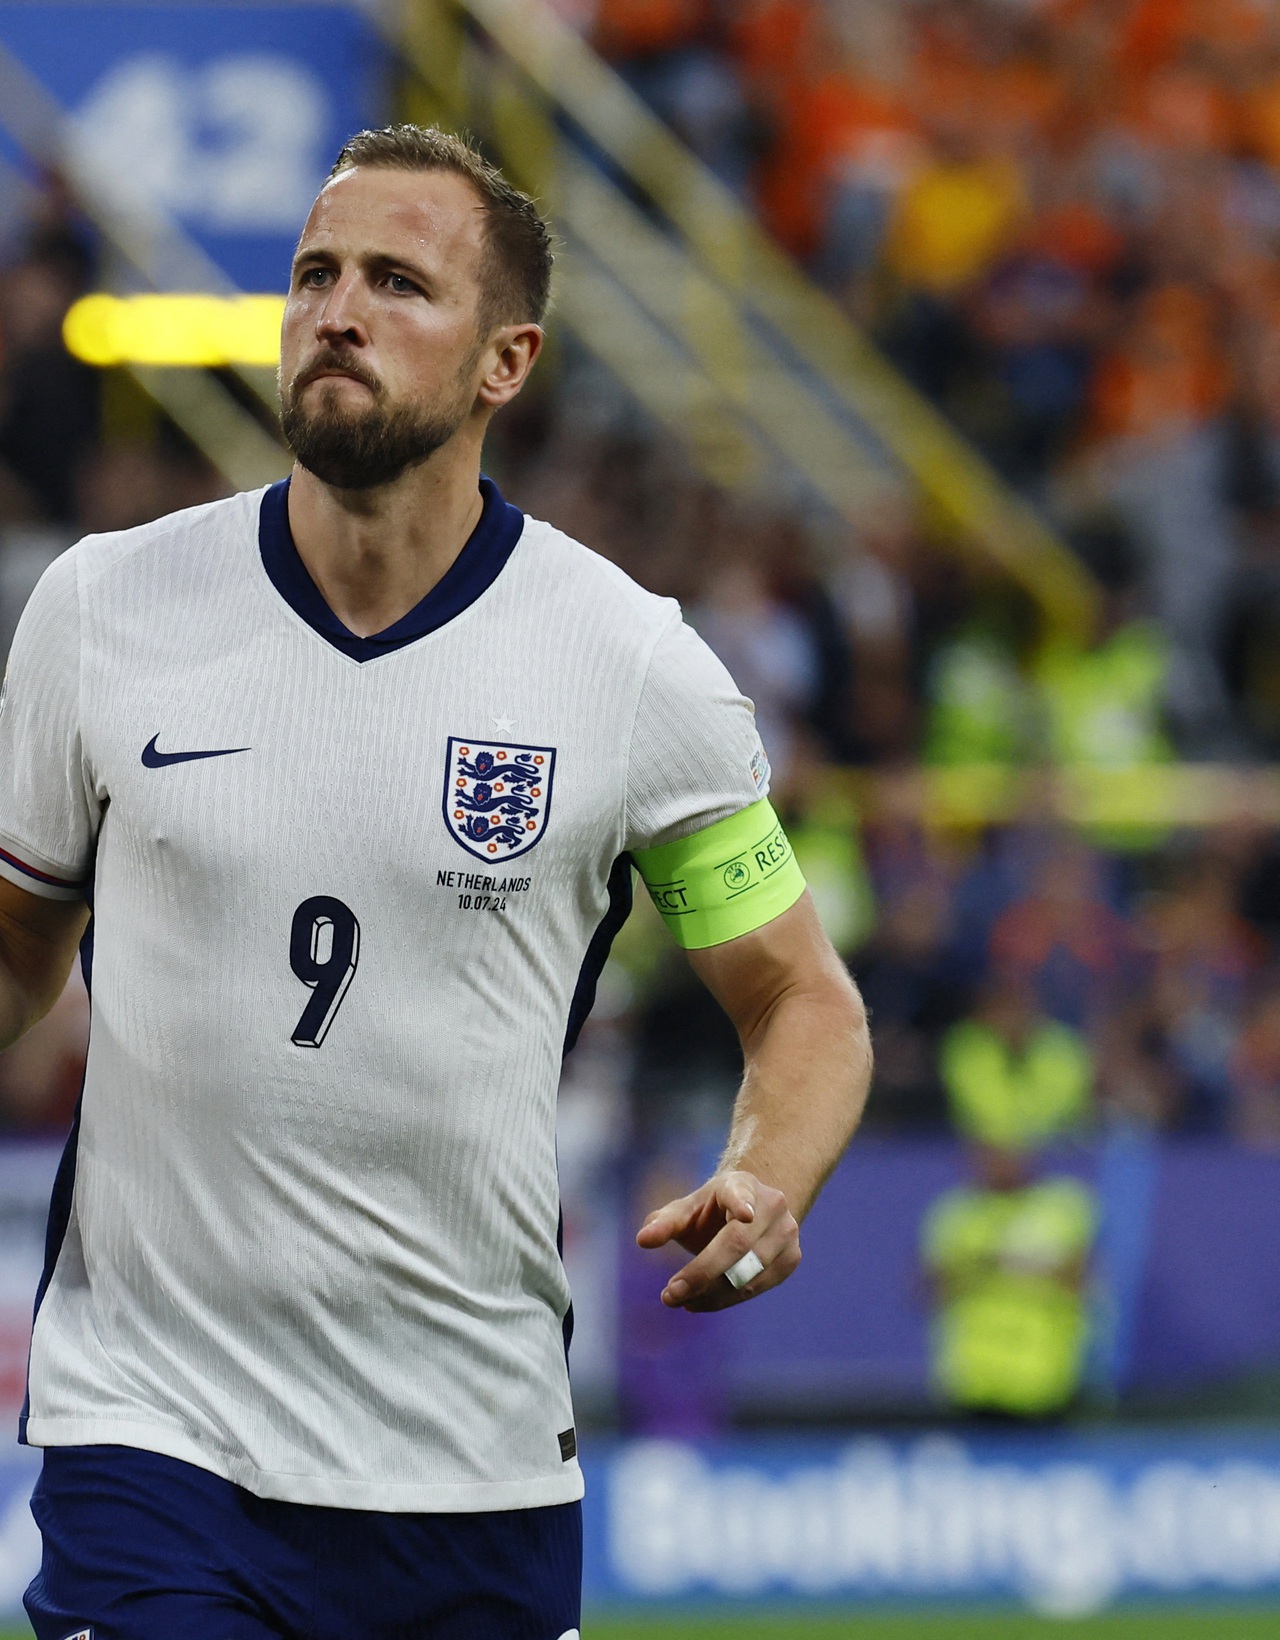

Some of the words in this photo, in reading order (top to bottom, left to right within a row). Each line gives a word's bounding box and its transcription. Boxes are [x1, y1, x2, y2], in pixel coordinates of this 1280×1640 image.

[70, 57, 325, 228] 42
[436, 870, 531, 892] NETHERLANDS
[458, 894, 506, 911] 10.07.24
[290, 895, 360, 1048] 9
